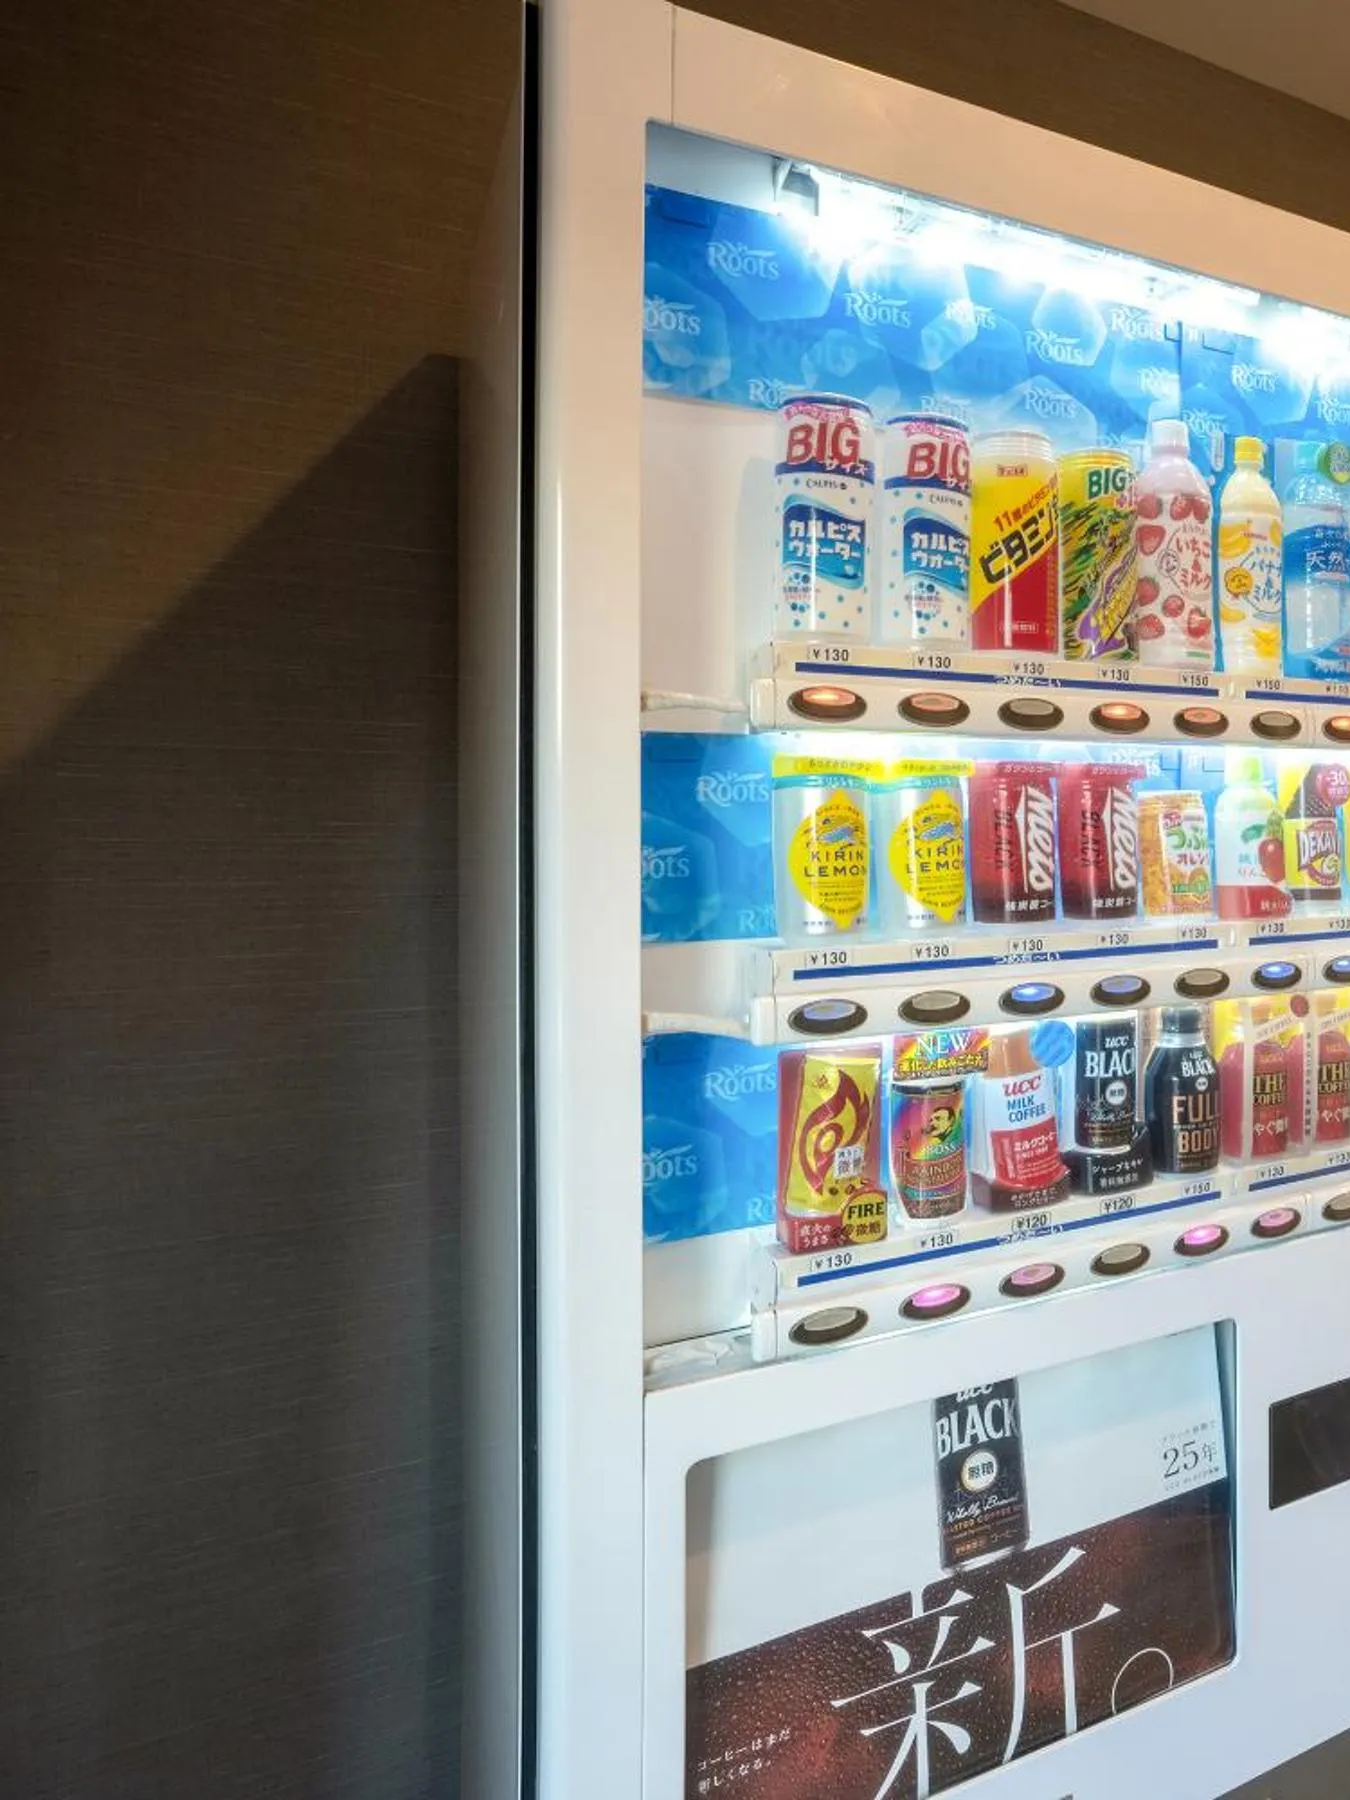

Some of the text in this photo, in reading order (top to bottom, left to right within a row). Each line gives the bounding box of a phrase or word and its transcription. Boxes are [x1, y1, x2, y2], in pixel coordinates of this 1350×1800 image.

[706, 240, 780, 281] Roots
[645, 295, 701, 336] oots
[842, 291, 912, 329] Roots
[786, 418, 861, 465] BIG
[1088, 467, 1127, 500] BIG
[789, 519, 863, 544] カルピス
[1306, 550, 1350, 571] 天然
[812, 649, 850, 662] ¥130
[917, 655, 952, 669] ¥130
[1014, 662, 1045, 676] ¥130
[1101, 669, 1131, 681] ¥130
[697, 768, 770, 807] Roots
[641, 845, 691, 880] ots
[915, 944, 950, 958] ¥130
[1013, 938, 1043, 952] ¥130
[810, 951, 848, 966] ¥130
[916, 1032, 971, 1060] NEW
[1084, 1048, 1136, 1078] BLAC
[705, 1062, 777, 1102] Roots
[1002, 1075, 1042, 1097] UCC
[1007, 1095, 1035, 1111] MILK
[1008, 1104, 1047, 1123] COFFEE
[643, 1144, 699, 1183] oots
[847, 1201, 885, 1220] FIRE
[1104, 1196, 1133, 1211] ¥120
[1016, 1213, 1048, 1229] ¥120
[919, 1233, 954, 1248] ¥130
[814, 1252, 853, 1270] ¥130
[935, 1397, 1020, 1462] BLACK
[697, 1725, 792, 1772] コーヒーはまだ
